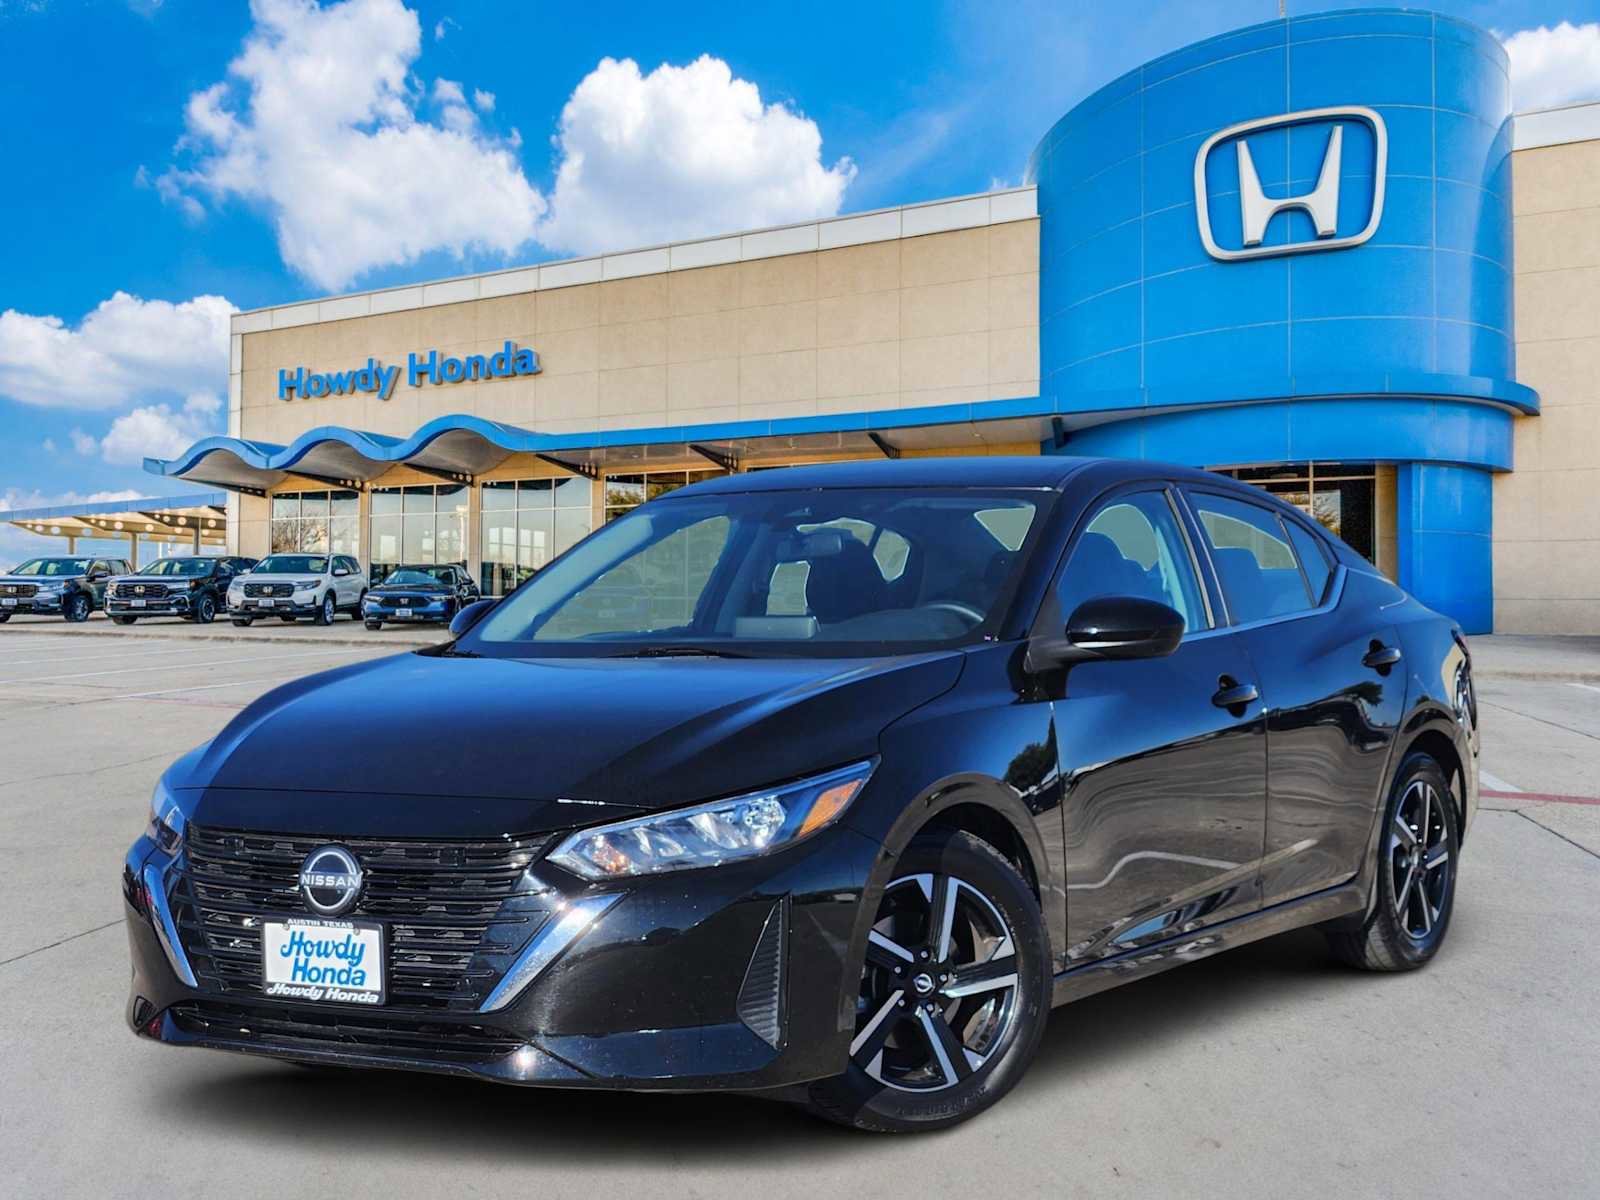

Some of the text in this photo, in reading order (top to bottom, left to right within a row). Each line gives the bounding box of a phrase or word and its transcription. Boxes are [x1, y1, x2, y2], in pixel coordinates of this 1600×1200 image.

[277, 340, 542, 401] Howdy Honda
[301, 875, 359, 887] NISSAN
[288, 919, 354, 929] AUSTIN TEXAS
[280, 930, 366, 967] Howdy
[292, 958, 366, 986] Honda
[266, 983, 379, 1003] Howdy Honda
